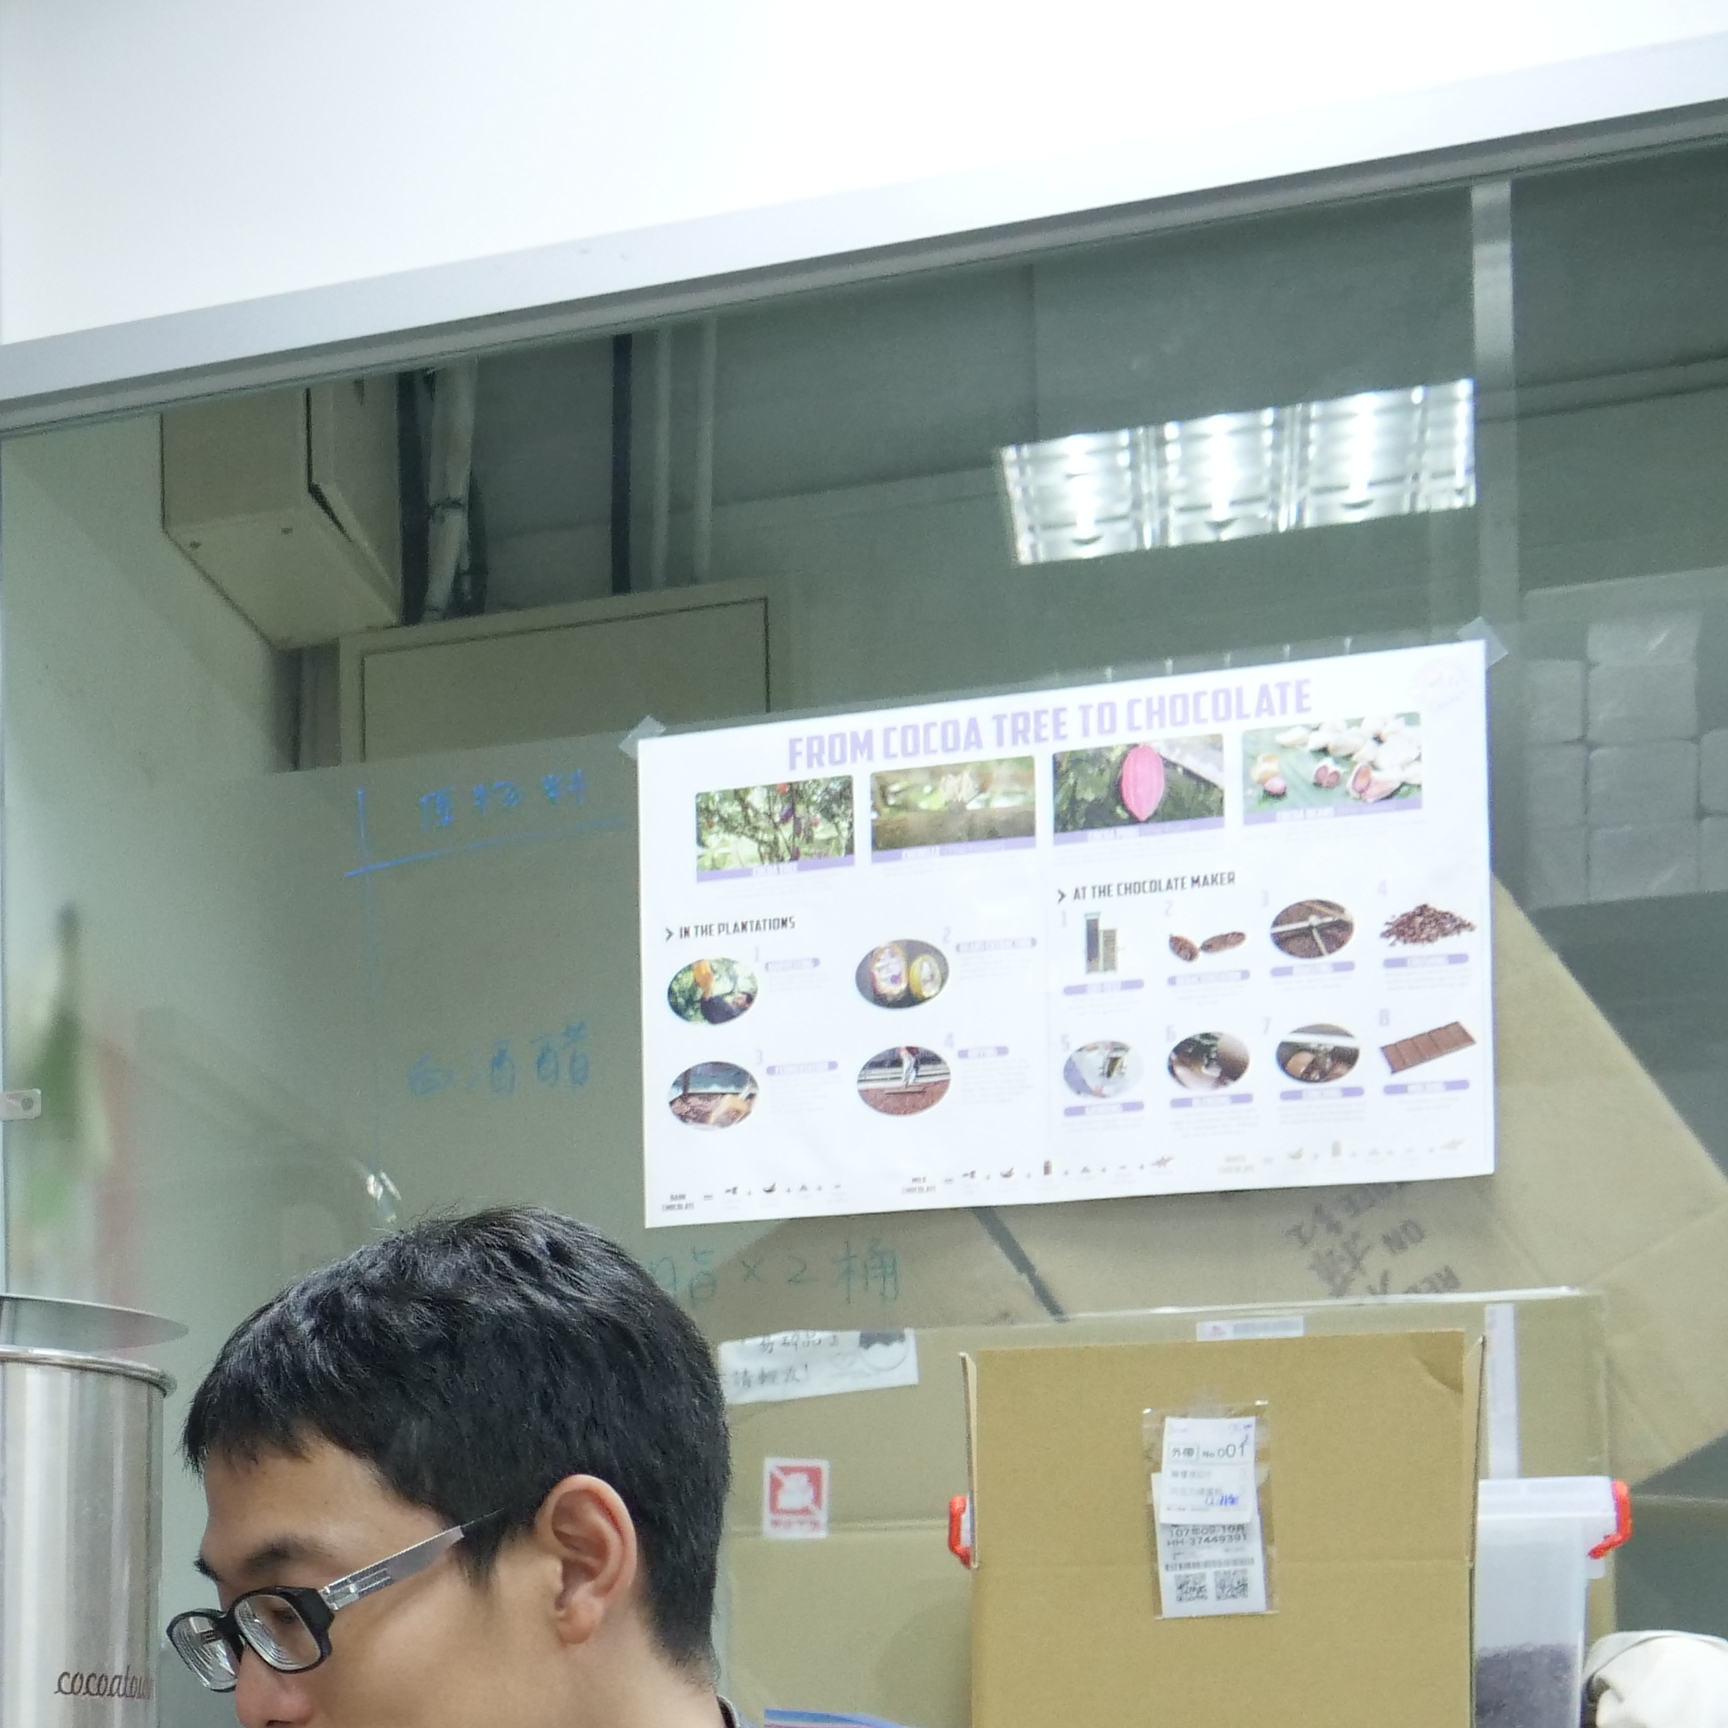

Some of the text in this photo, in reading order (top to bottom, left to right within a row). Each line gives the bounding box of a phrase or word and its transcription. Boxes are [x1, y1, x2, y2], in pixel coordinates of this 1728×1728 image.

[789, 678, 1312, 771] FROM COCOA TREE TO CHOCOLATE
[1073, 871, 1236, 901] AT THE CHOCOLATE MAKER
[680, 915, 796, 940] IN THE PLANTATIONS
